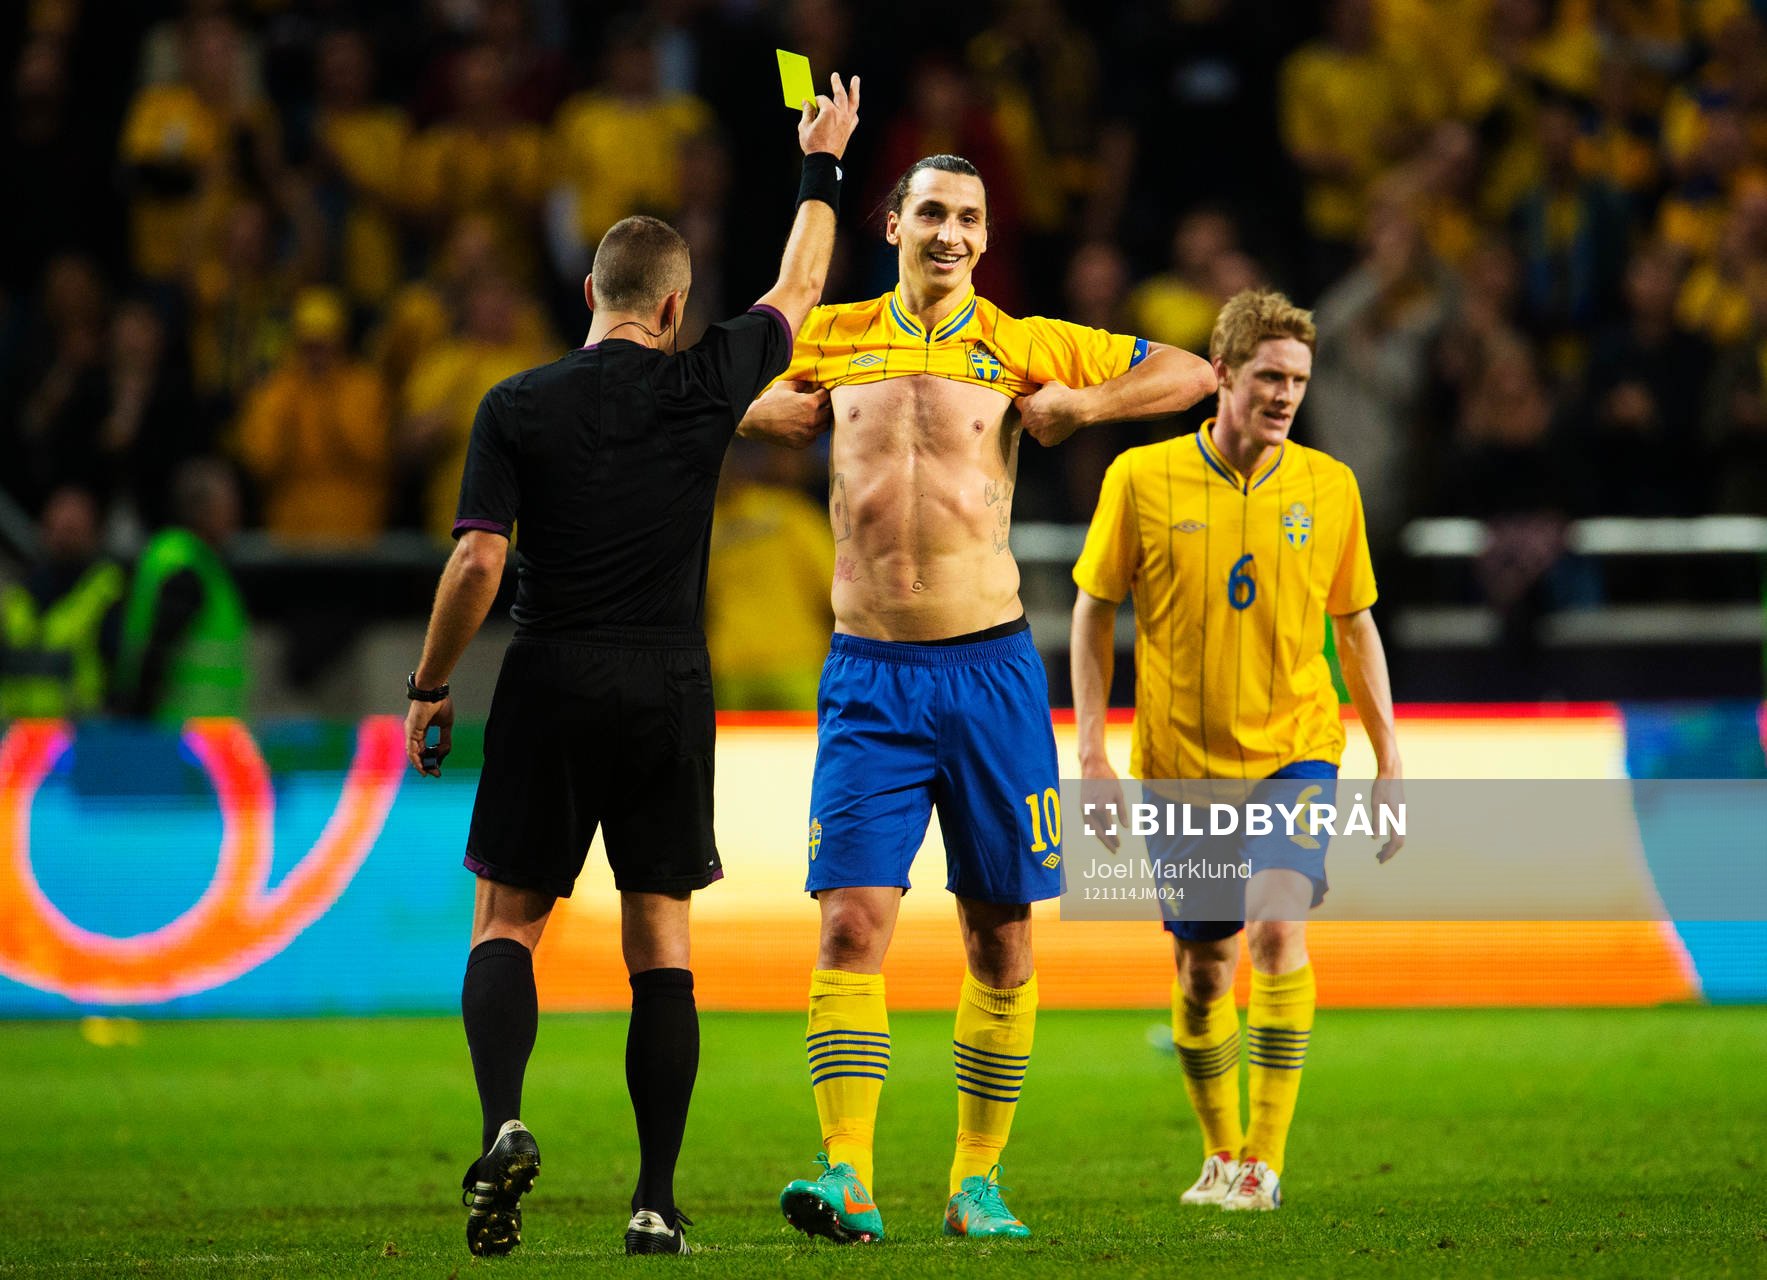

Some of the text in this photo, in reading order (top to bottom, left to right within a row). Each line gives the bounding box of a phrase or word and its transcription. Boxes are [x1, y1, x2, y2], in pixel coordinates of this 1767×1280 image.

[1228, 553, 1256, 611] 6
[1025, 787, 1060, 852] 10
[1295, 784, 1323, 834] 6
